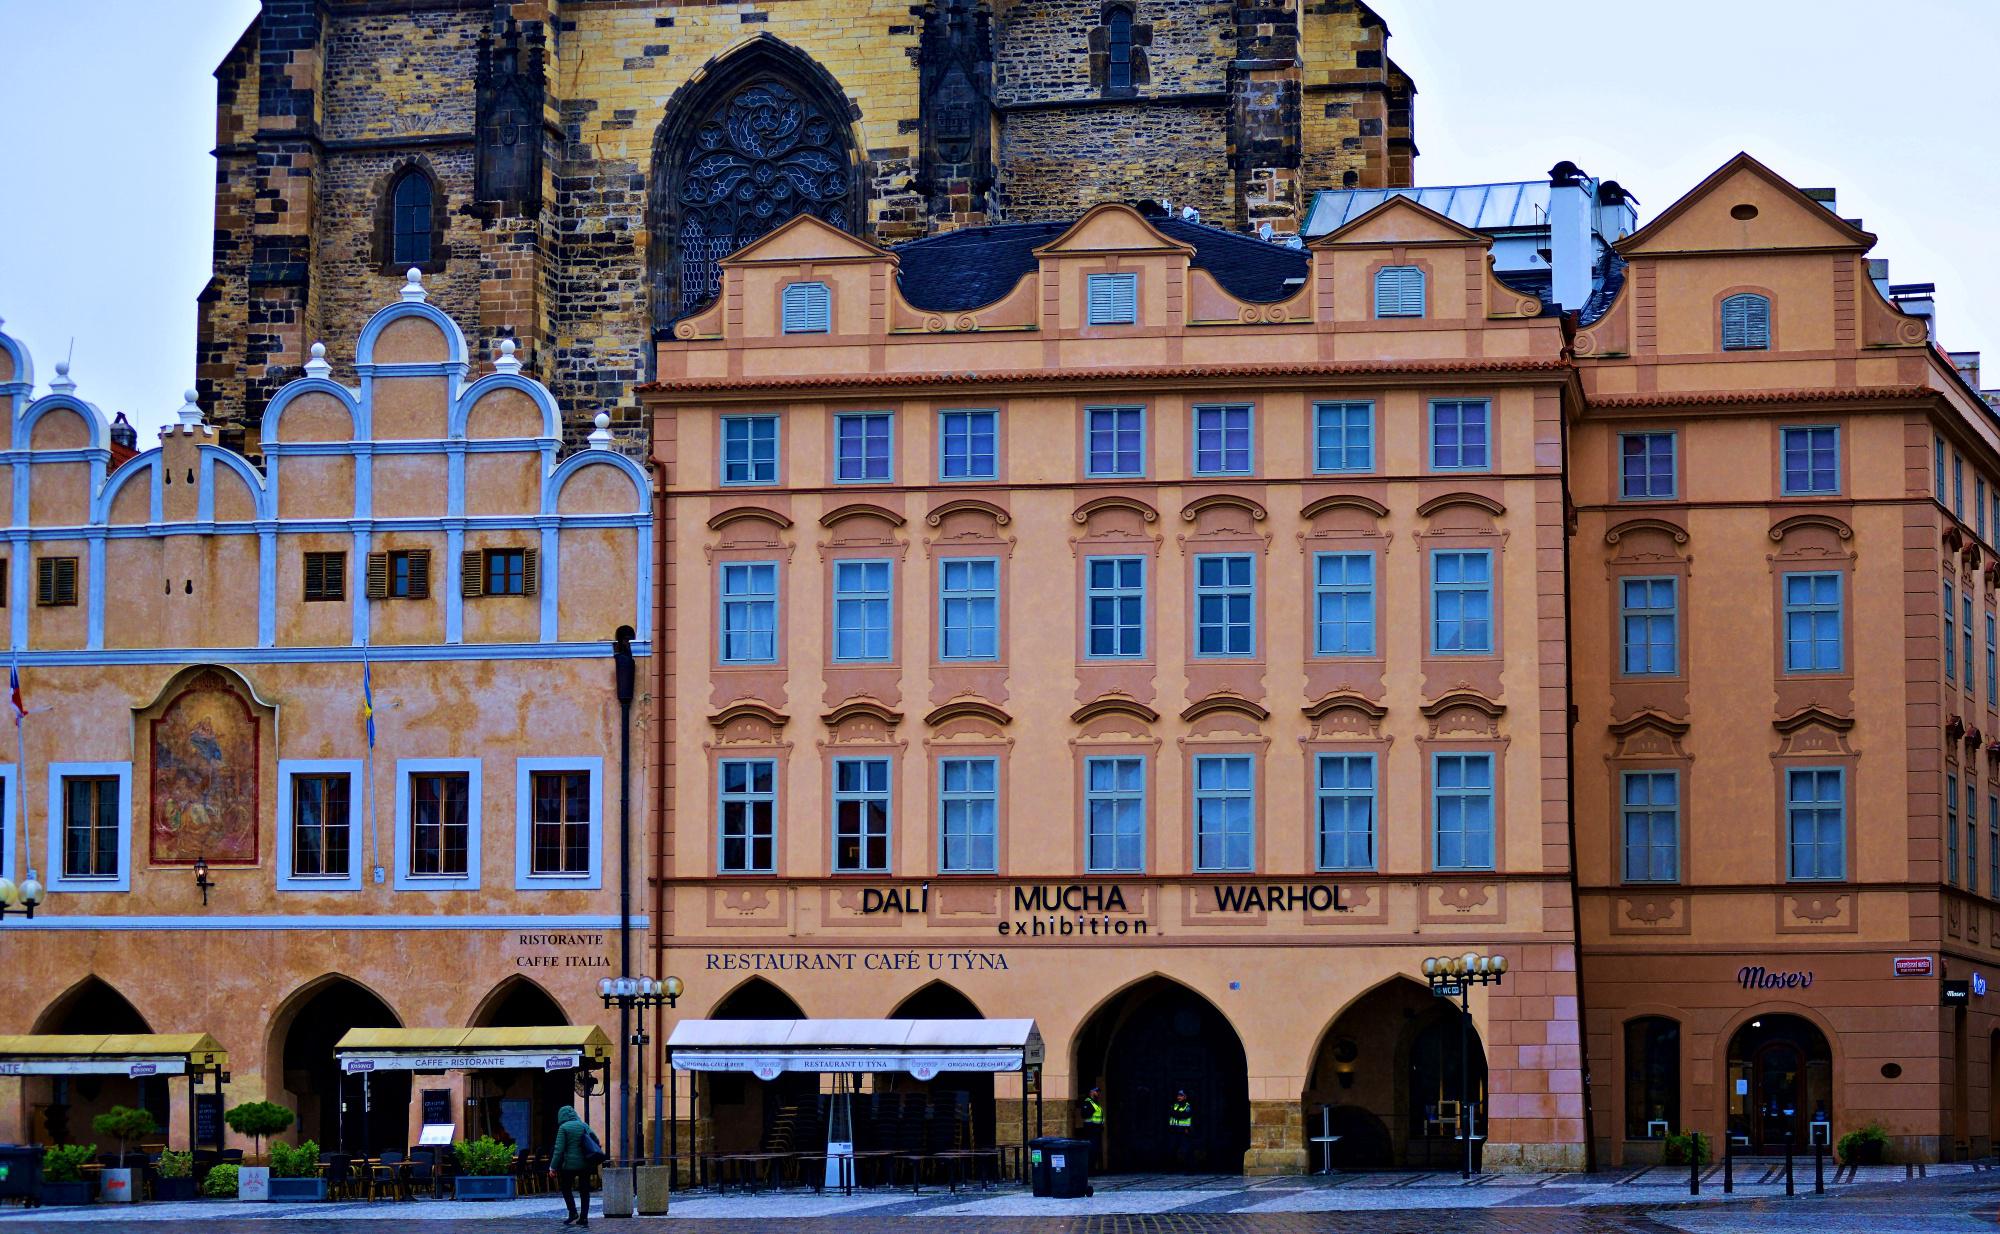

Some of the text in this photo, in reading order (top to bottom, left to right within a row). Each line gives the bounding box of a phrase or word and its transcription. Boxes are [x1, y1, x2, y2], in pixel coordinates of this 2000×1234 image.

[1014, 886, 1126, 911] MUCHA
[1214, 885, 1347, 911] WARHOL
[998, 915, 1147, 935] exhibition
[520, 935, 602, 945] RISTORANTE
[516, 957, 610, 967] CAFFE ITALIA
[705, 950, 1008, 970] RESTAURANT CAFÉ U TÝNA
[1738, 967, 1813, 989] Moser
[1442, 987, 1452, 995] WC
[415, 1059, 443, 1067] CAFFE
[451, 1058, 505, 1066] RISTORANTE
[866, 1059, 887, 1068] TÝNA
